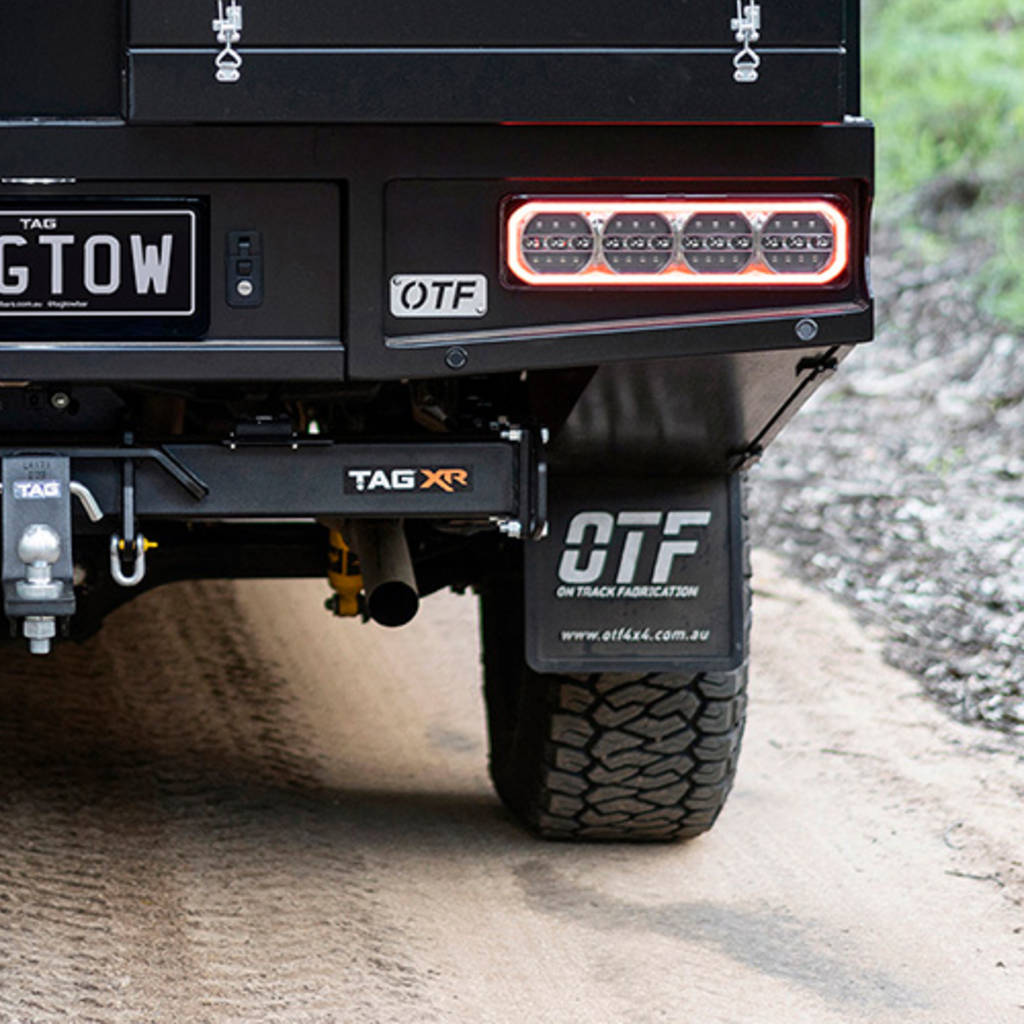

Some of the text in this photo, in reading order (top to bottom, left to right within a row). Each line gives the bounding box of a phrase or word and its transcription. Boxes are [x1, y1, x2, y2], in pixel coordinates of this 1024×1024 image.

[19, 218, 57, 230] TAG
[400, 281, 477, 310] OTF
[347, 468, 469, 493] TAG XR
[17, 482, 61, 498] TAG
[557, 511, 712, 585] OTF
[556, 585, 699, 598] ON TRACK FABRICATION
[560, 628, 710, 642] www.otf4x4.com.au
